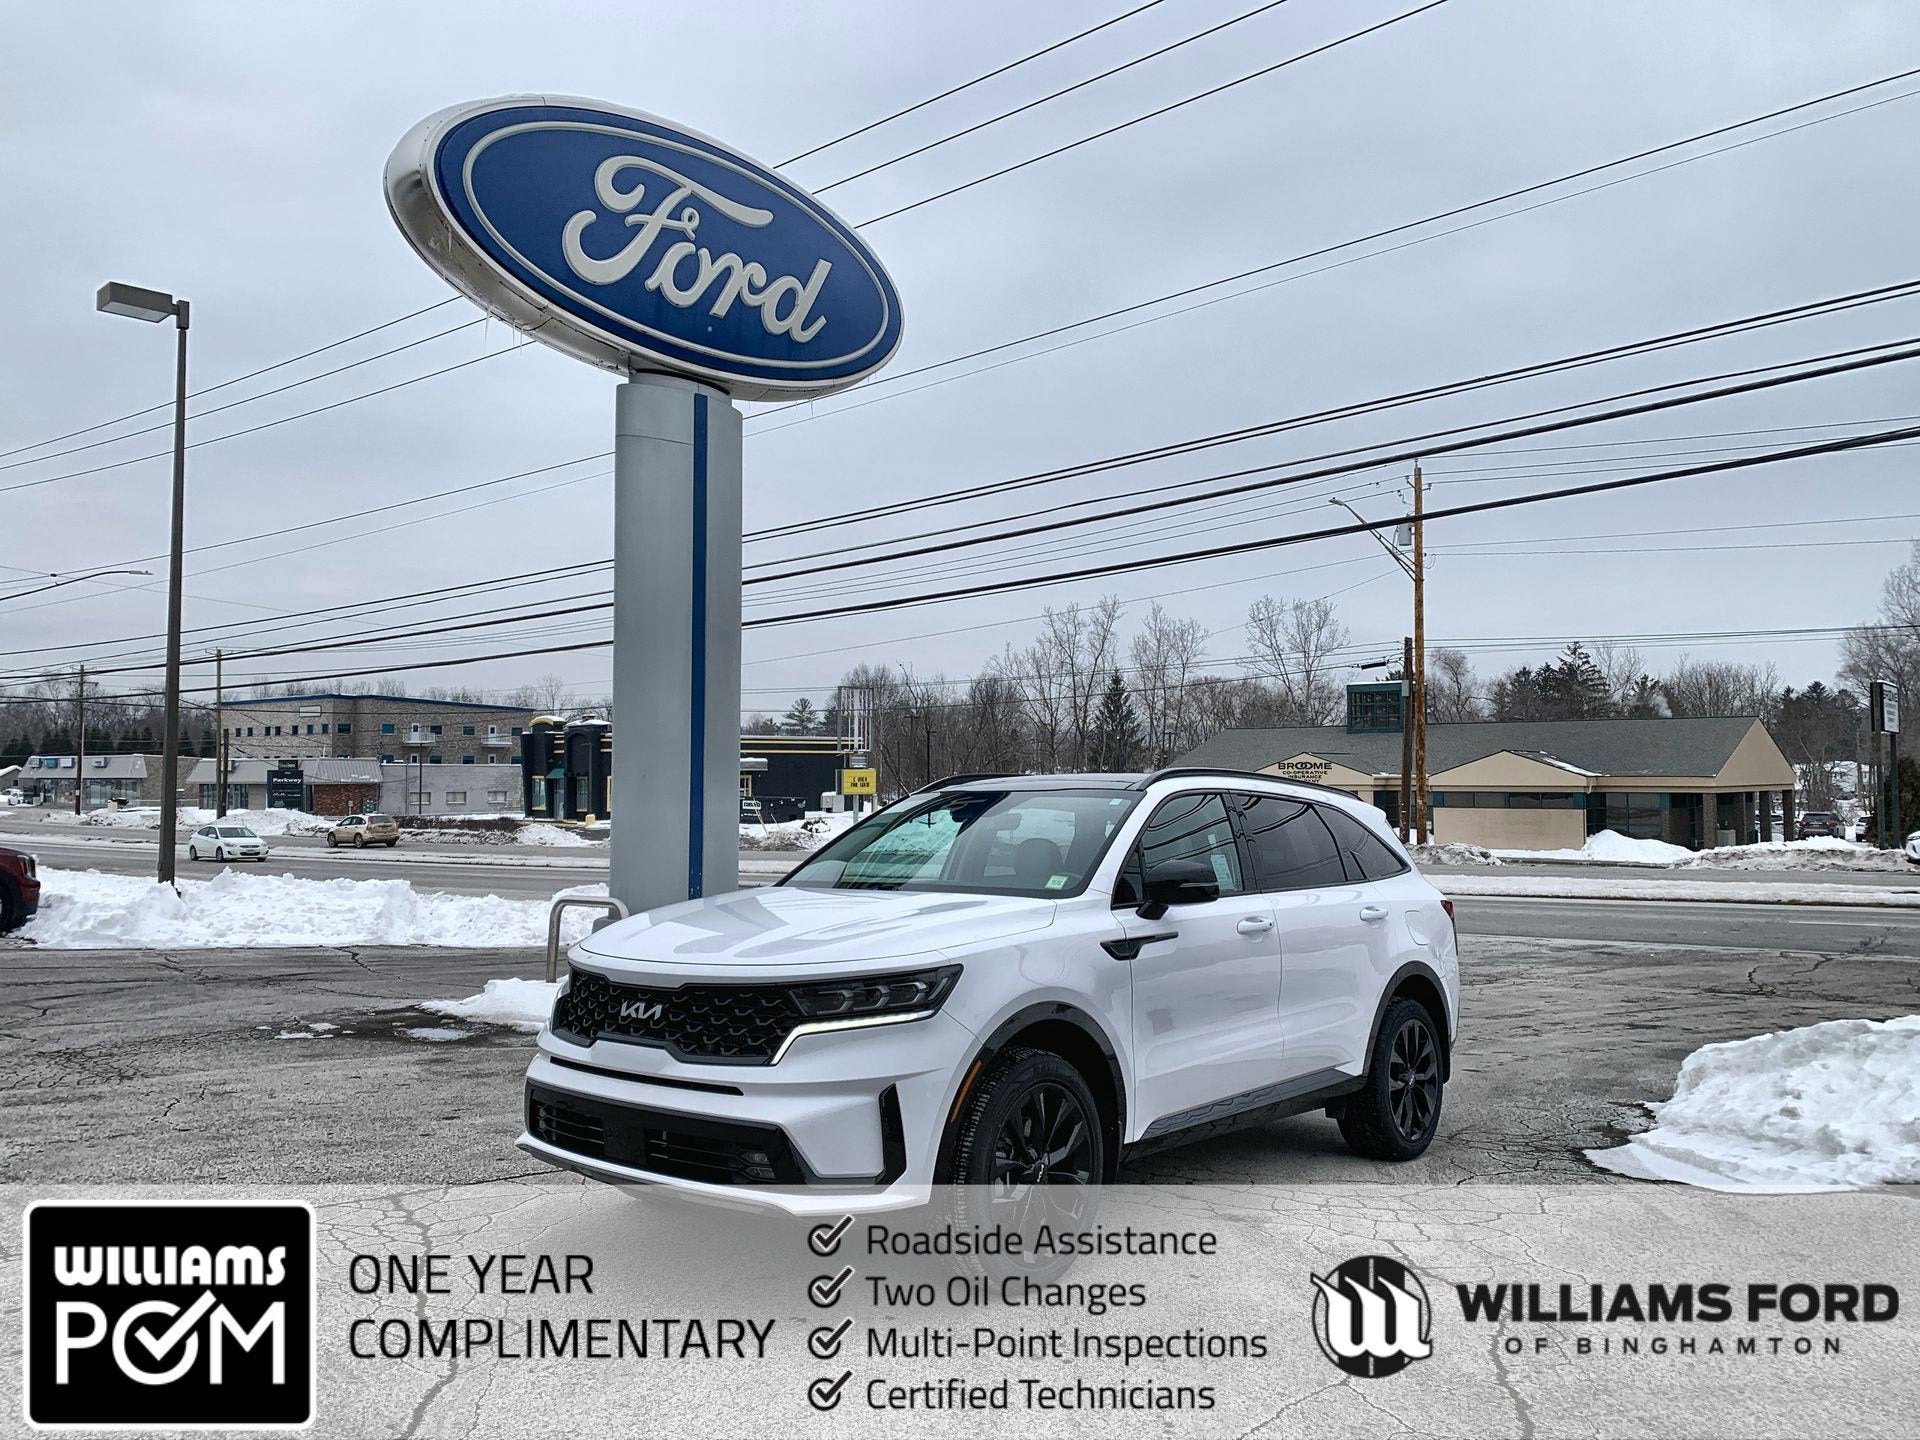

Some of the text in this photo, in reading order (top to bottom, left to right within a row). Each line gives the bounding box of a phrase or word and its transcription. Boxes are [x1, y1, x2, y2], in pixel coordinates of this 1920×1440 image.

[561, 155, 834, 344] Ford
[1278, 762, 1332, 770] BROOME
[621, 1000, 663, 1020] KIA
